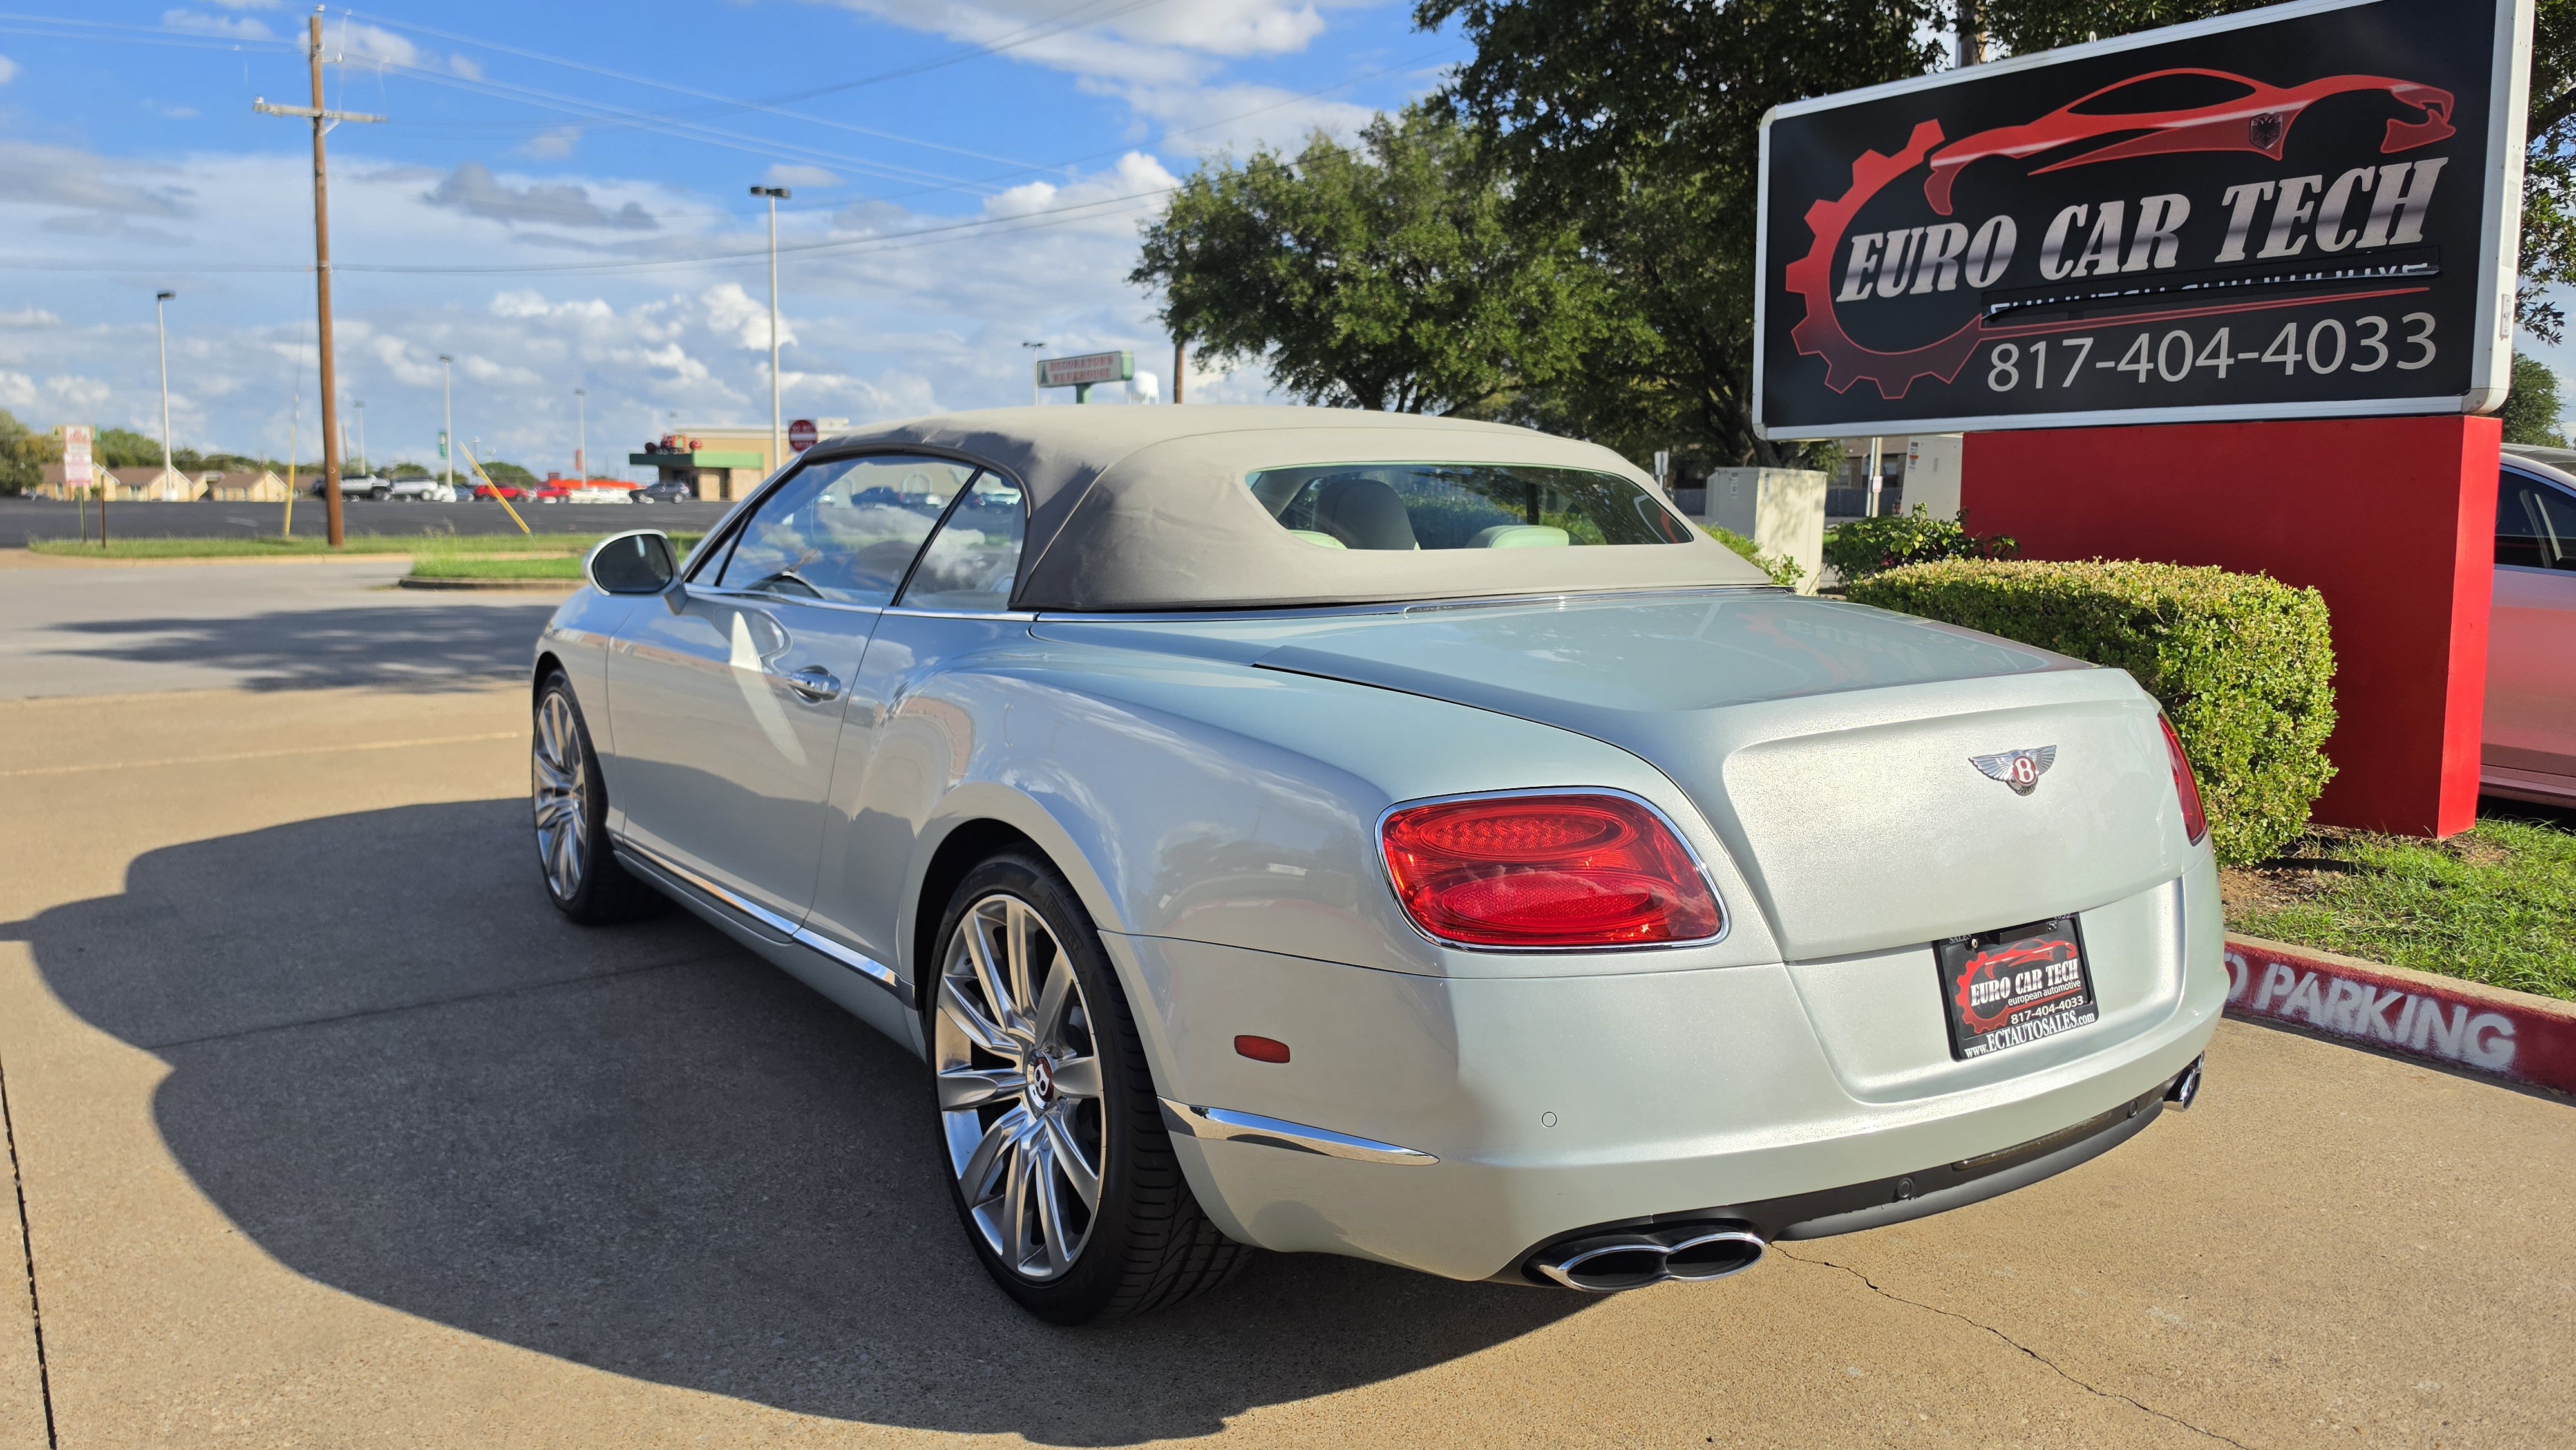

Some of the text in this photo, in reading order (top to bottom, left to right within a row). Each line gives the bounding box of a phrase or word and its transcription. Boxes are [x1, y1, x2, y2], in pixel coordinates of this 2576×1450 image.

[1835, 214, 2018, 303] EURO
[2042, 193, 2192, 280] CAR
[2214, 156, 2448, 263] TECH
[1987, 312, 2438, 393] 817-404-4033
[1971, 959, 2079, 1006] EURO CAR TECH
[2008, 979, 2081, 1006] european automotive
[2011, 995, 2084, 1024] 817-404-4033
[2253, 962, 2517, 1072] PARKING
[1964, 1010, 2096, 1059] www.ECTAUTOSALES.com
